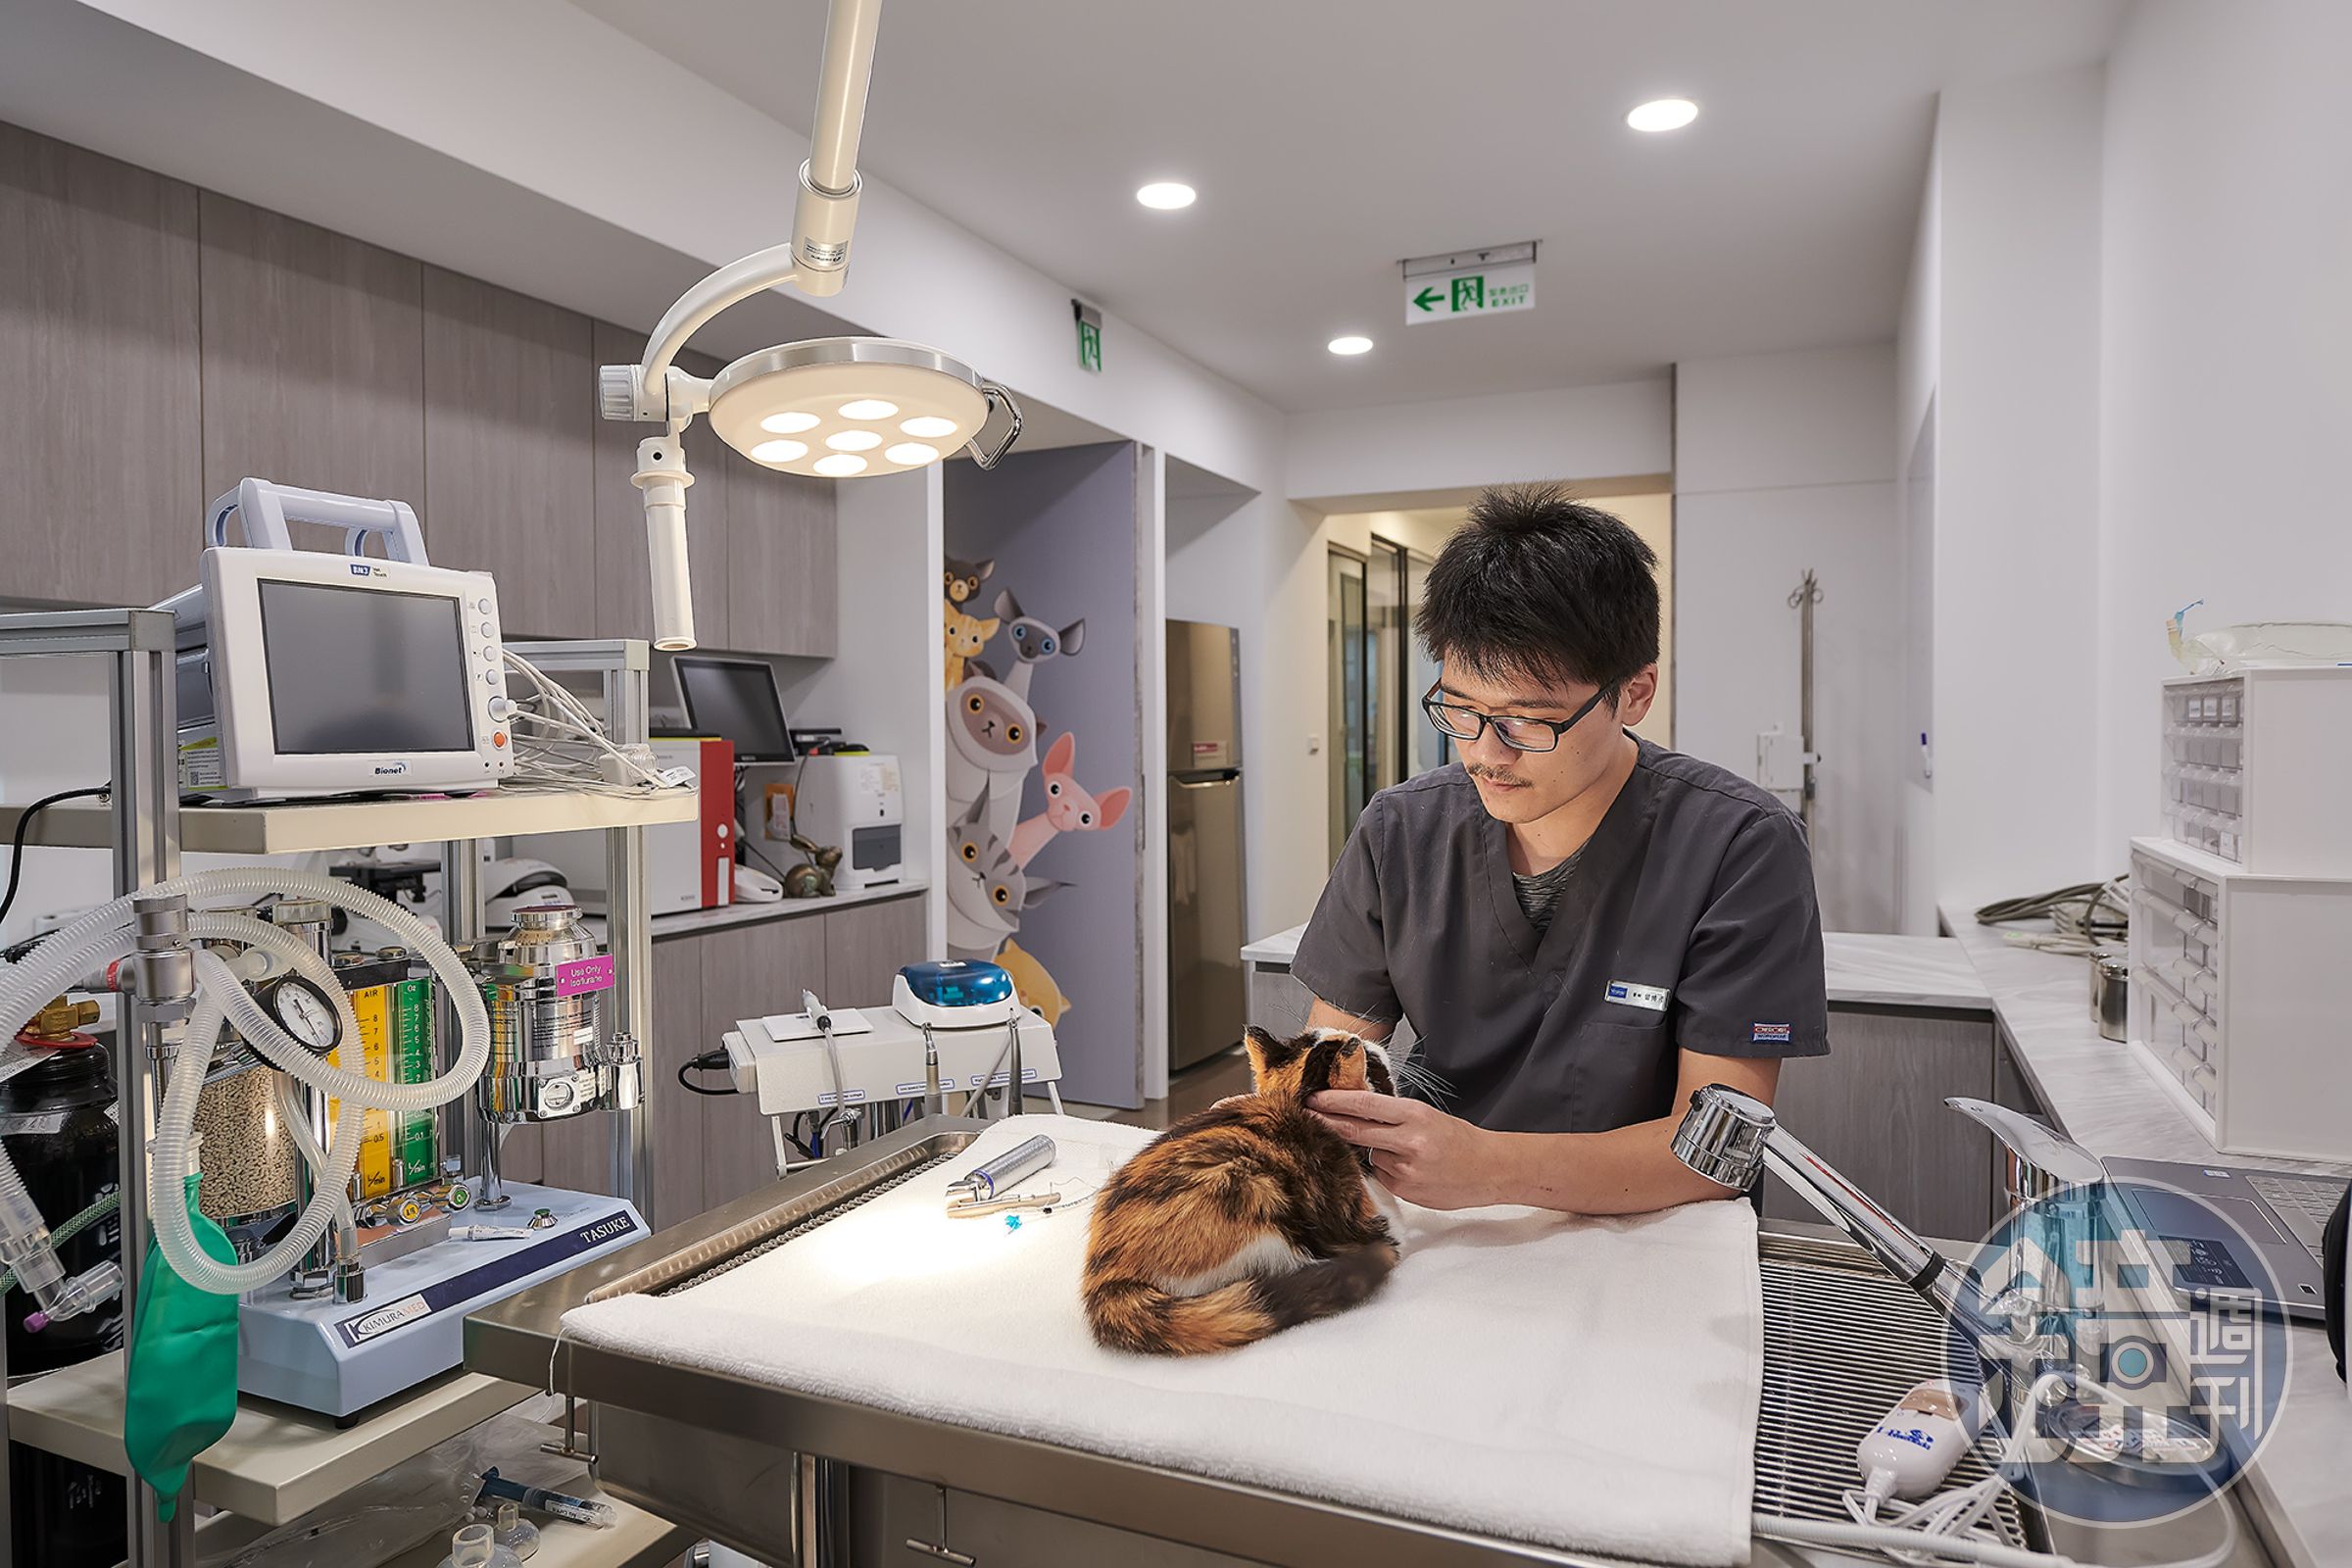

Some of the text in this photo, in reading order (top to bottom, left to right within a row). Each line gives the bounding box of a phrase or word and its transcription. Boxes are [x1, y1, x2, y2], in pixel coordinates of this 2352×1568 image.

[1491, 295, 1526, 308] EXIT
[374, 766, 403, 775] Bionet
[570, 965, 602, 978] Use Only
[364, 989, 379, 999] AIR
[373, 1133, 384, 1143] 0.5
[415, 1132, 424, 1141] 0.1
[579, 1216, 631, 1244] TASUKE
[363, 1300, 426, 1333] KIMURAMED
